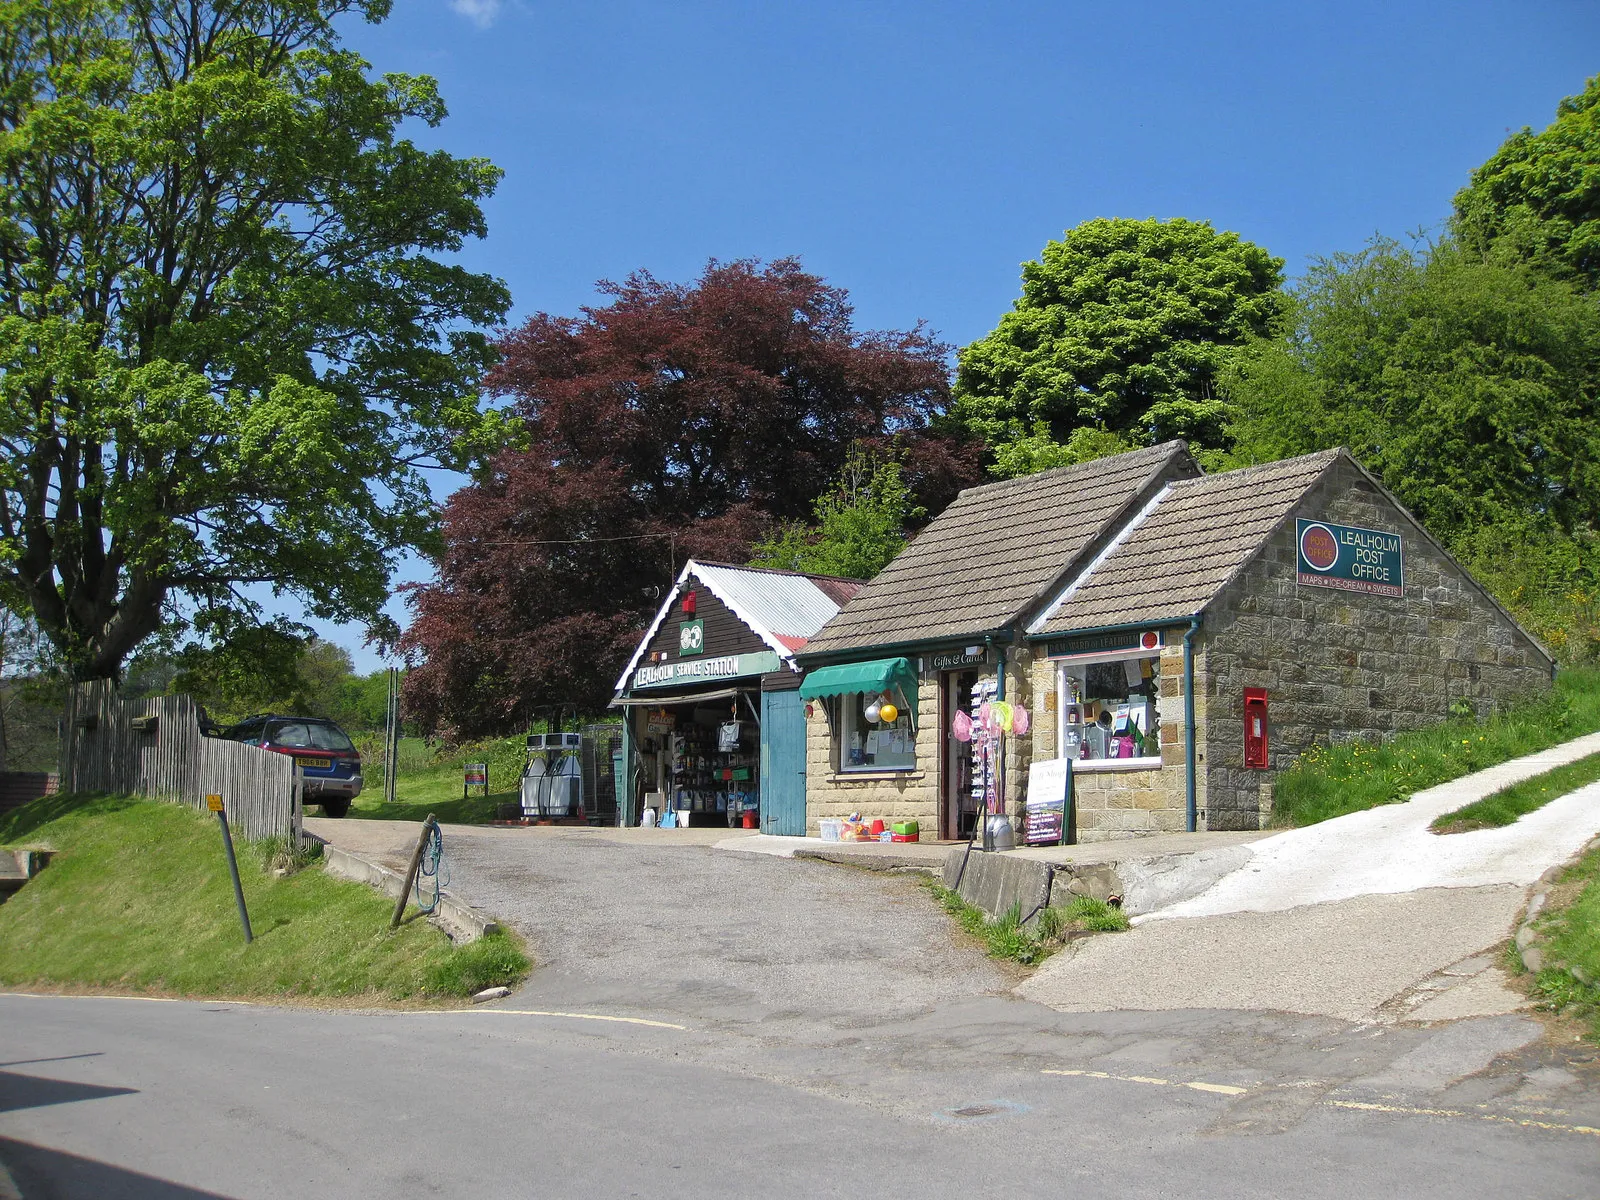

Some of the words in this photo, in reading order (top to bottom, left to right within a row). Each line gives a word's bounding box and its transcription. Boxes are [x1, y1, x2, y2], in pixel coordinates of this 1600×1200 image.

[1310, 536, 1329, 547] POST
[1340, 530, 1398, 552] LEALHOLM
[1307, 546, 1333, 560] OFFICE
[1356, 547, 1384, 565] POST
[1352, 563, 1390, 581] OFFICE
[1301, 574, 1323, 585] MAPS
[1329, 579, 1366, 591] ICE-CREAM
[1372, 584, 1399, 596] SWEETS
[1068, 640, 1090, 651] WARD
[1100, 633, 1139, 648] LEALHOLM
[933, 655, 952, 670] Gifts
[952, 654, 960, 665] &
[960, 653, 984, 664] Cards
[637, 665, 673, 686] LEALHOLM
[676, 662, 701, 677] SERVICE
[704, 657, 738, 676] STATION
